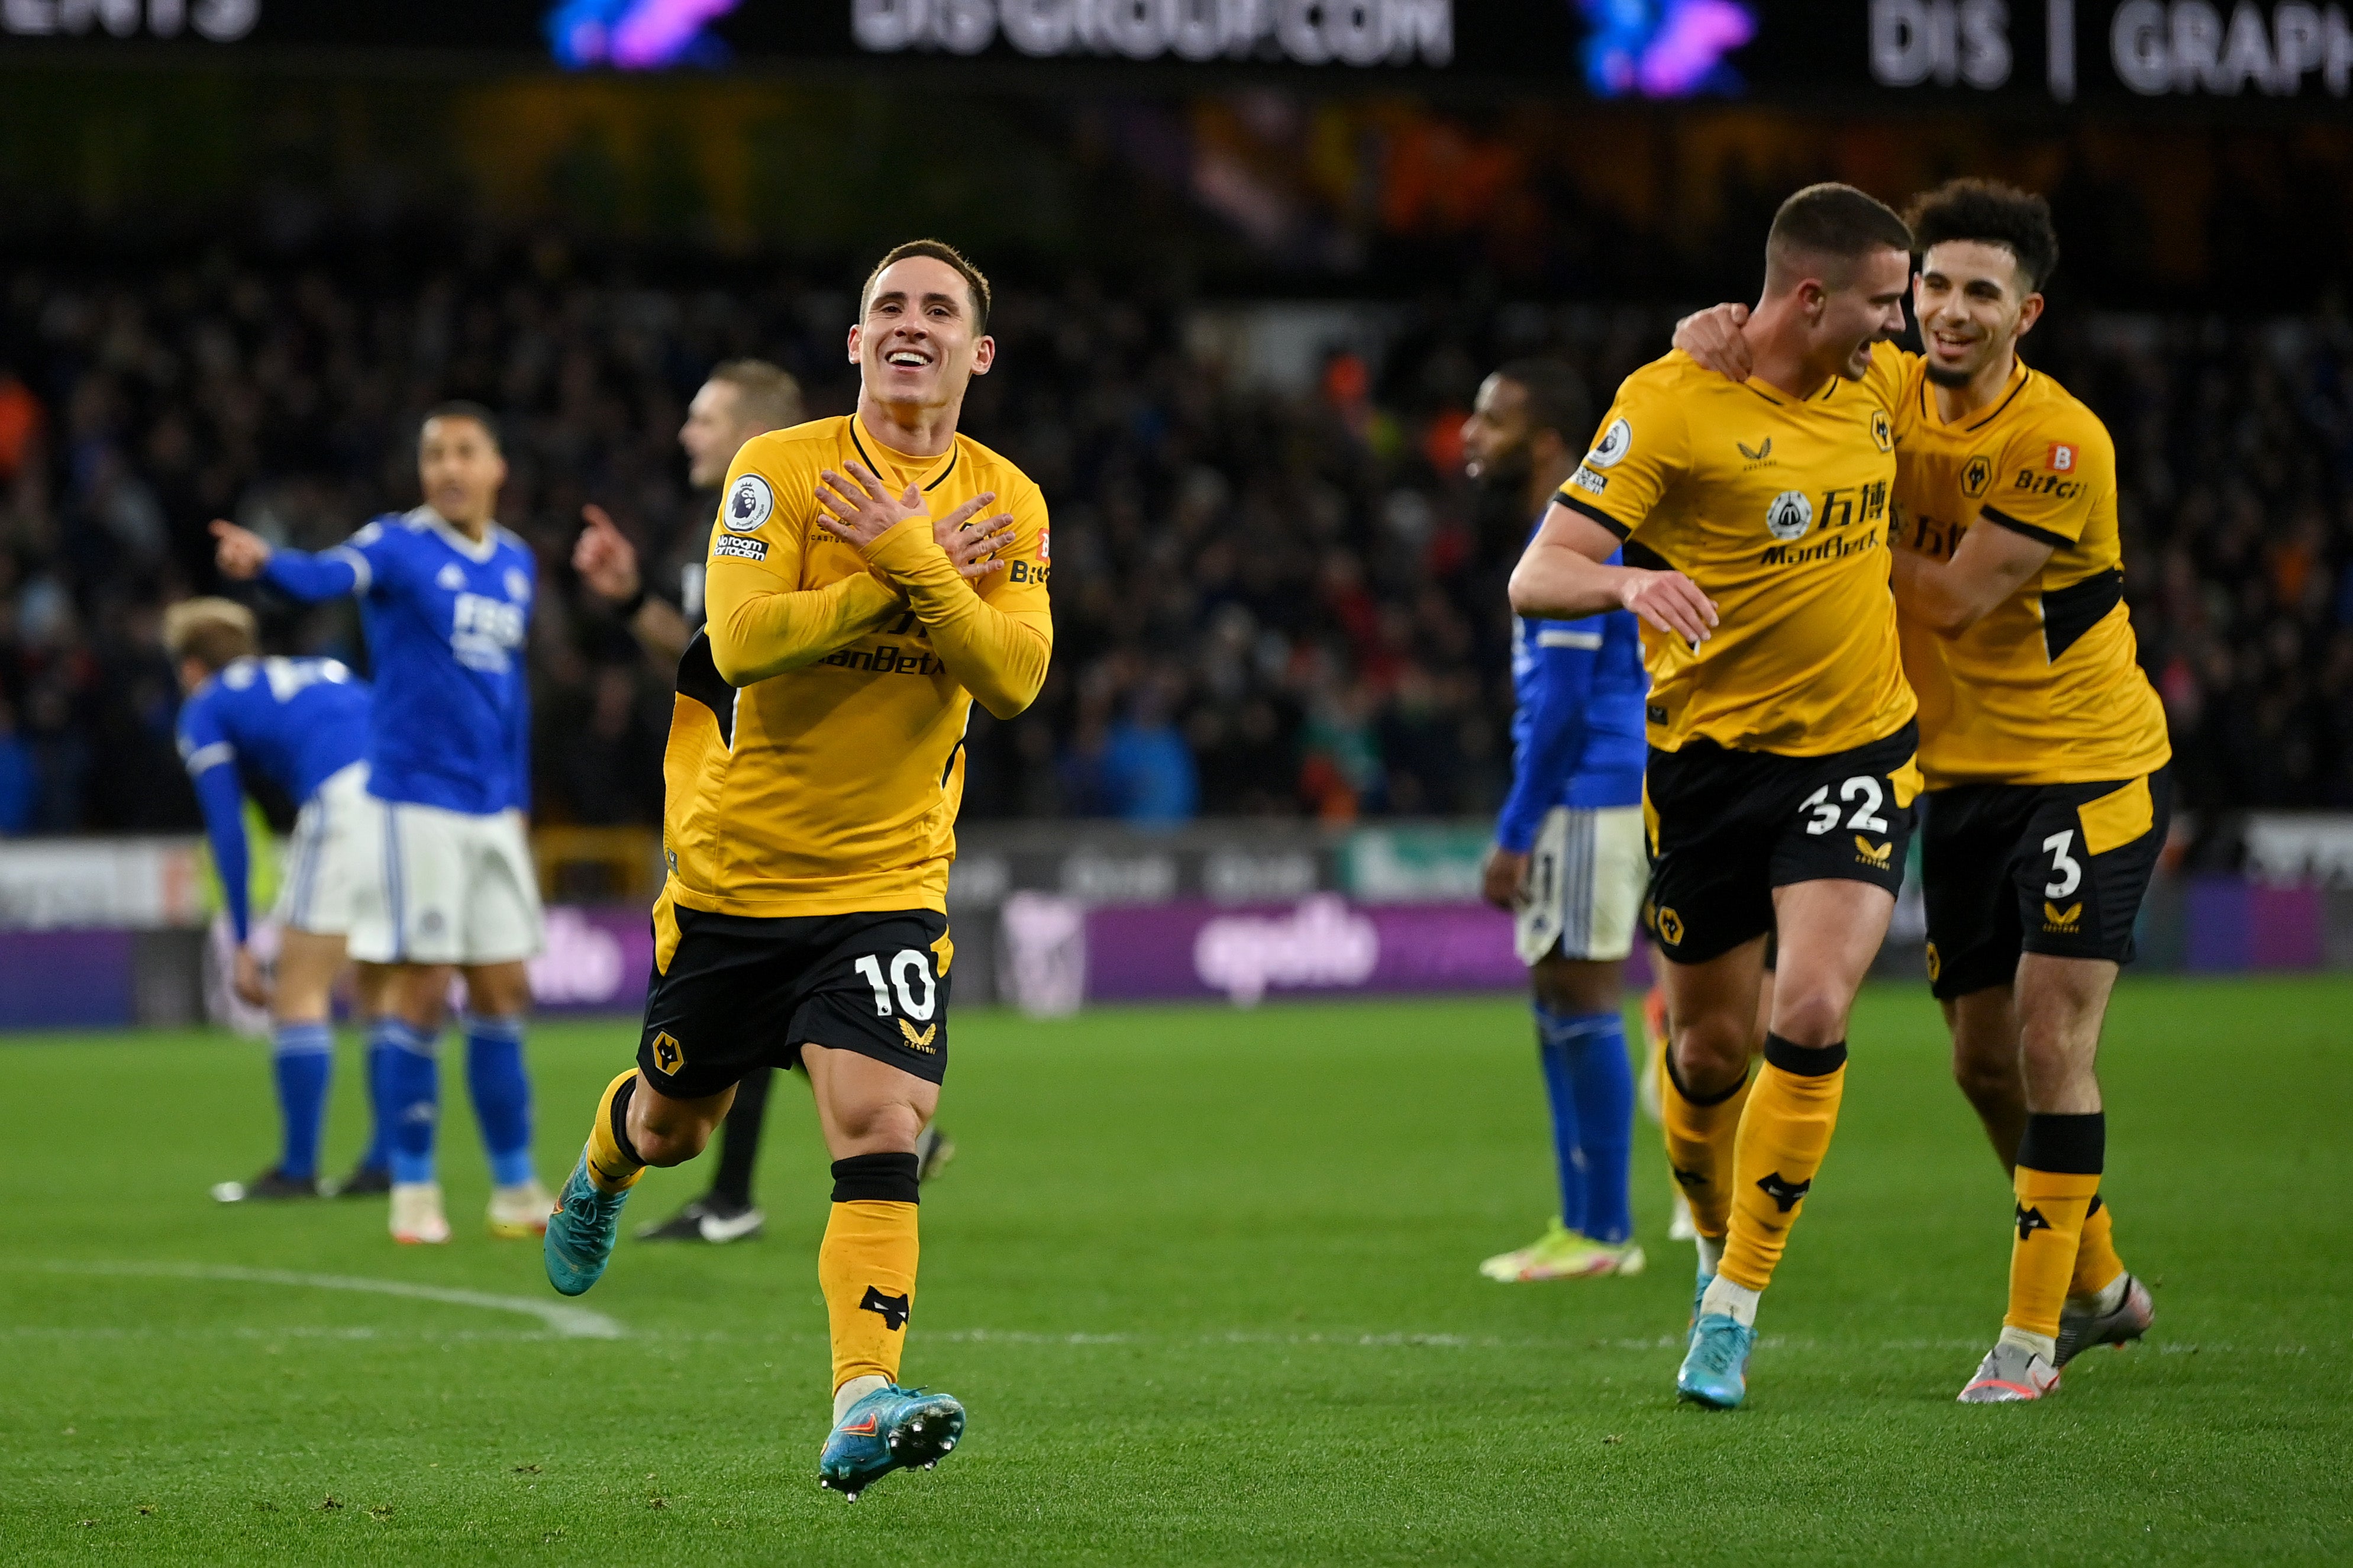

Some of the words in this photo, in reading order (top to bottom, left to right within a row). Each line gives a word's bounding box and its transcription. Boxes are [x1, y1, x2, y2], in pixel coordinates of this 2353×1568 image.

[1867, 0, 2010, 89] DIS
[2054, 445, 2071, 470] B
[714, 546, 727, 556] or
[724, 546, 765, 562] racism
[728, 536, 762, 551] room
[1797, 775, 1889, 835] 32
[2042, 828, 2082, 899] 3
[855, 949, 936, 1021] 10
